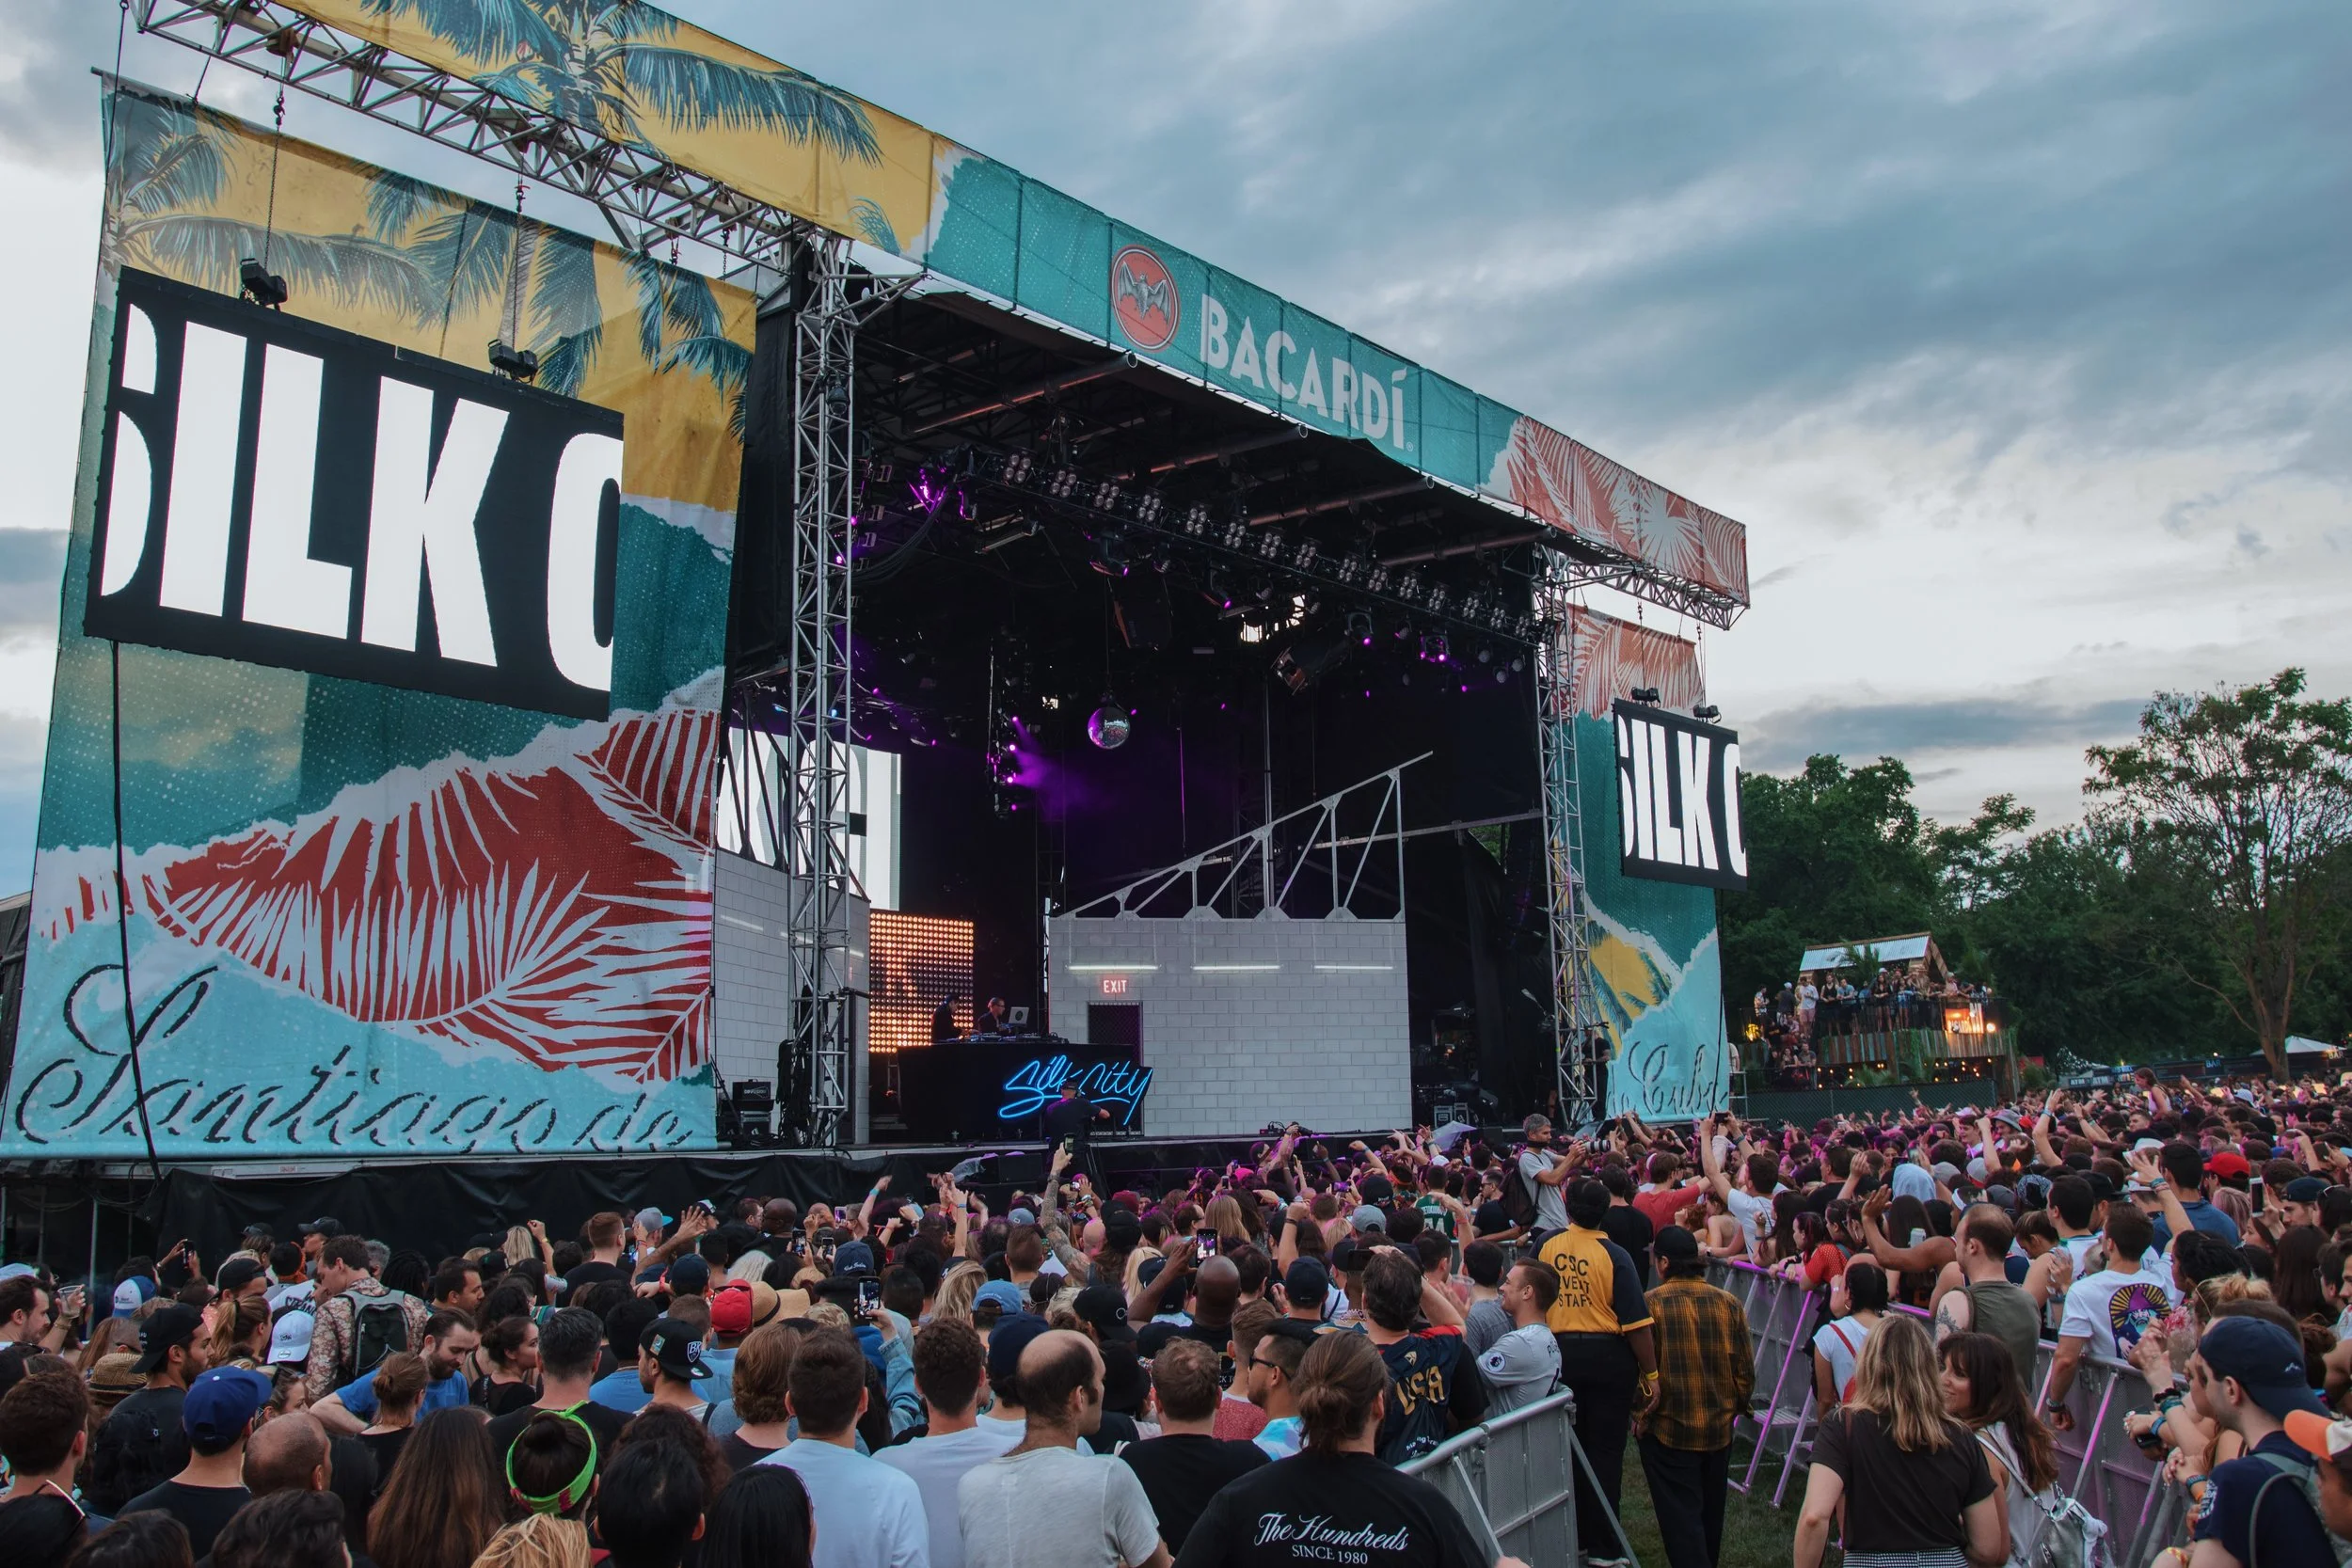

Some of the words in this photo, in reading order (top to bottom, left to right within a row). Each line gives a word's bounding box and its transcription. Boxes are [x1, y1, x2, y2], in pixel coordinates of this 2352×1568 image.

[1200, 293, 1407, 450] BACARDÍ
[1104, 979, 1127, 993] EXIT
[15, 964, 558, 1154] Santiago
[572, 1092, 694, 1152] de
[2205, 1059, 2221, 1069] BAR
[1554, 1253, 1589, 1276] CSC
[1396, 1366, 1445, 1416] USA
[1253, 1513, 1293, 1546] The
[1291, 1514, 1409, 1551] Hundreds
[1292, 1544, 1335, 1560] SINCE
[1337, 1550, 1368, 1565] 1980
